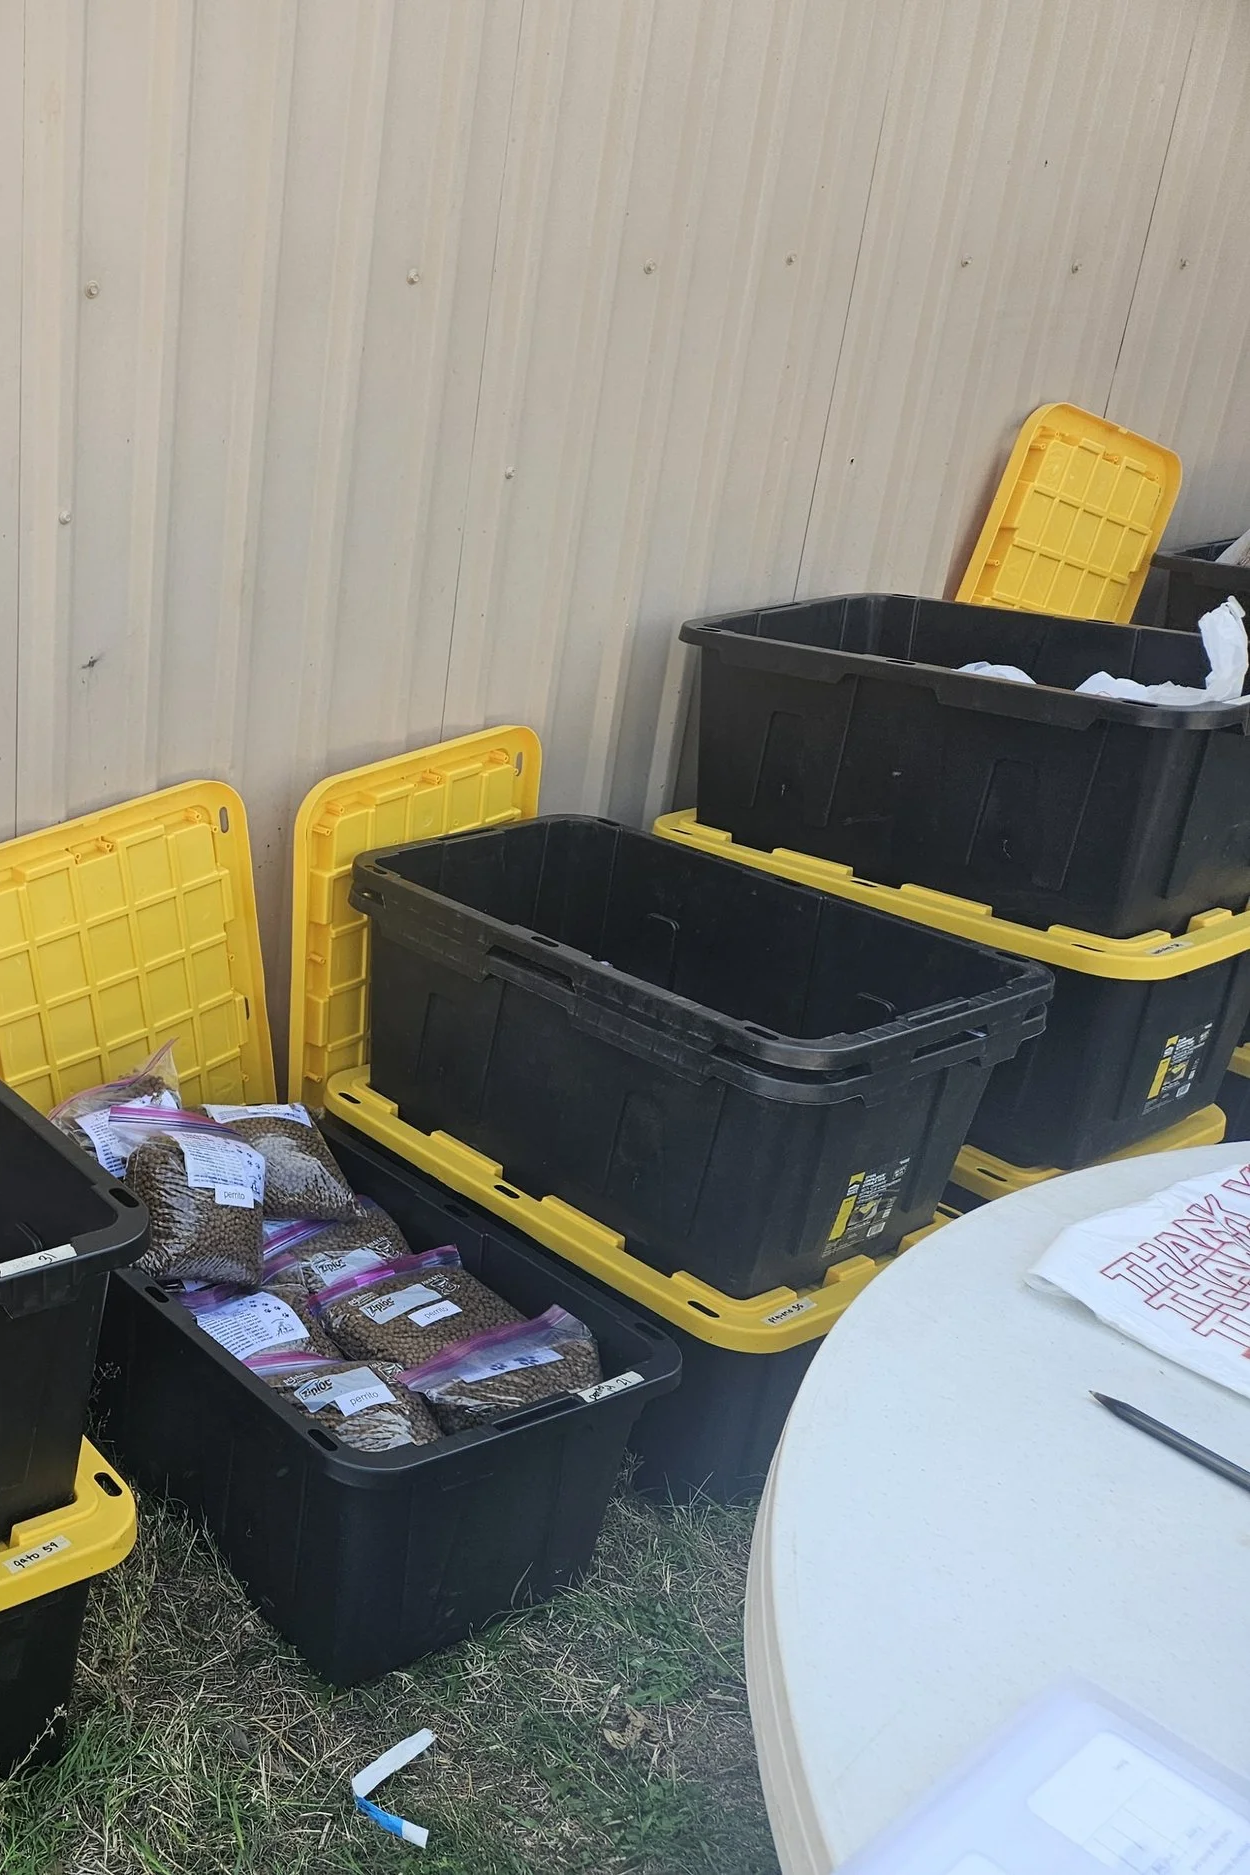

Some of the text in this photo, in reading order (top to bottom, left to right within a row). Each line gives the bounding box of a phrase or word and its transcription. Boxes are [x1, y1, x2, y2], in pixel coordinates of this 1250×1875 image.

[223, 1190, 246, 1201] perrito
[349, 1391, 379, 1406] perrito
[13, 1541, 59, 1568] gato 59
